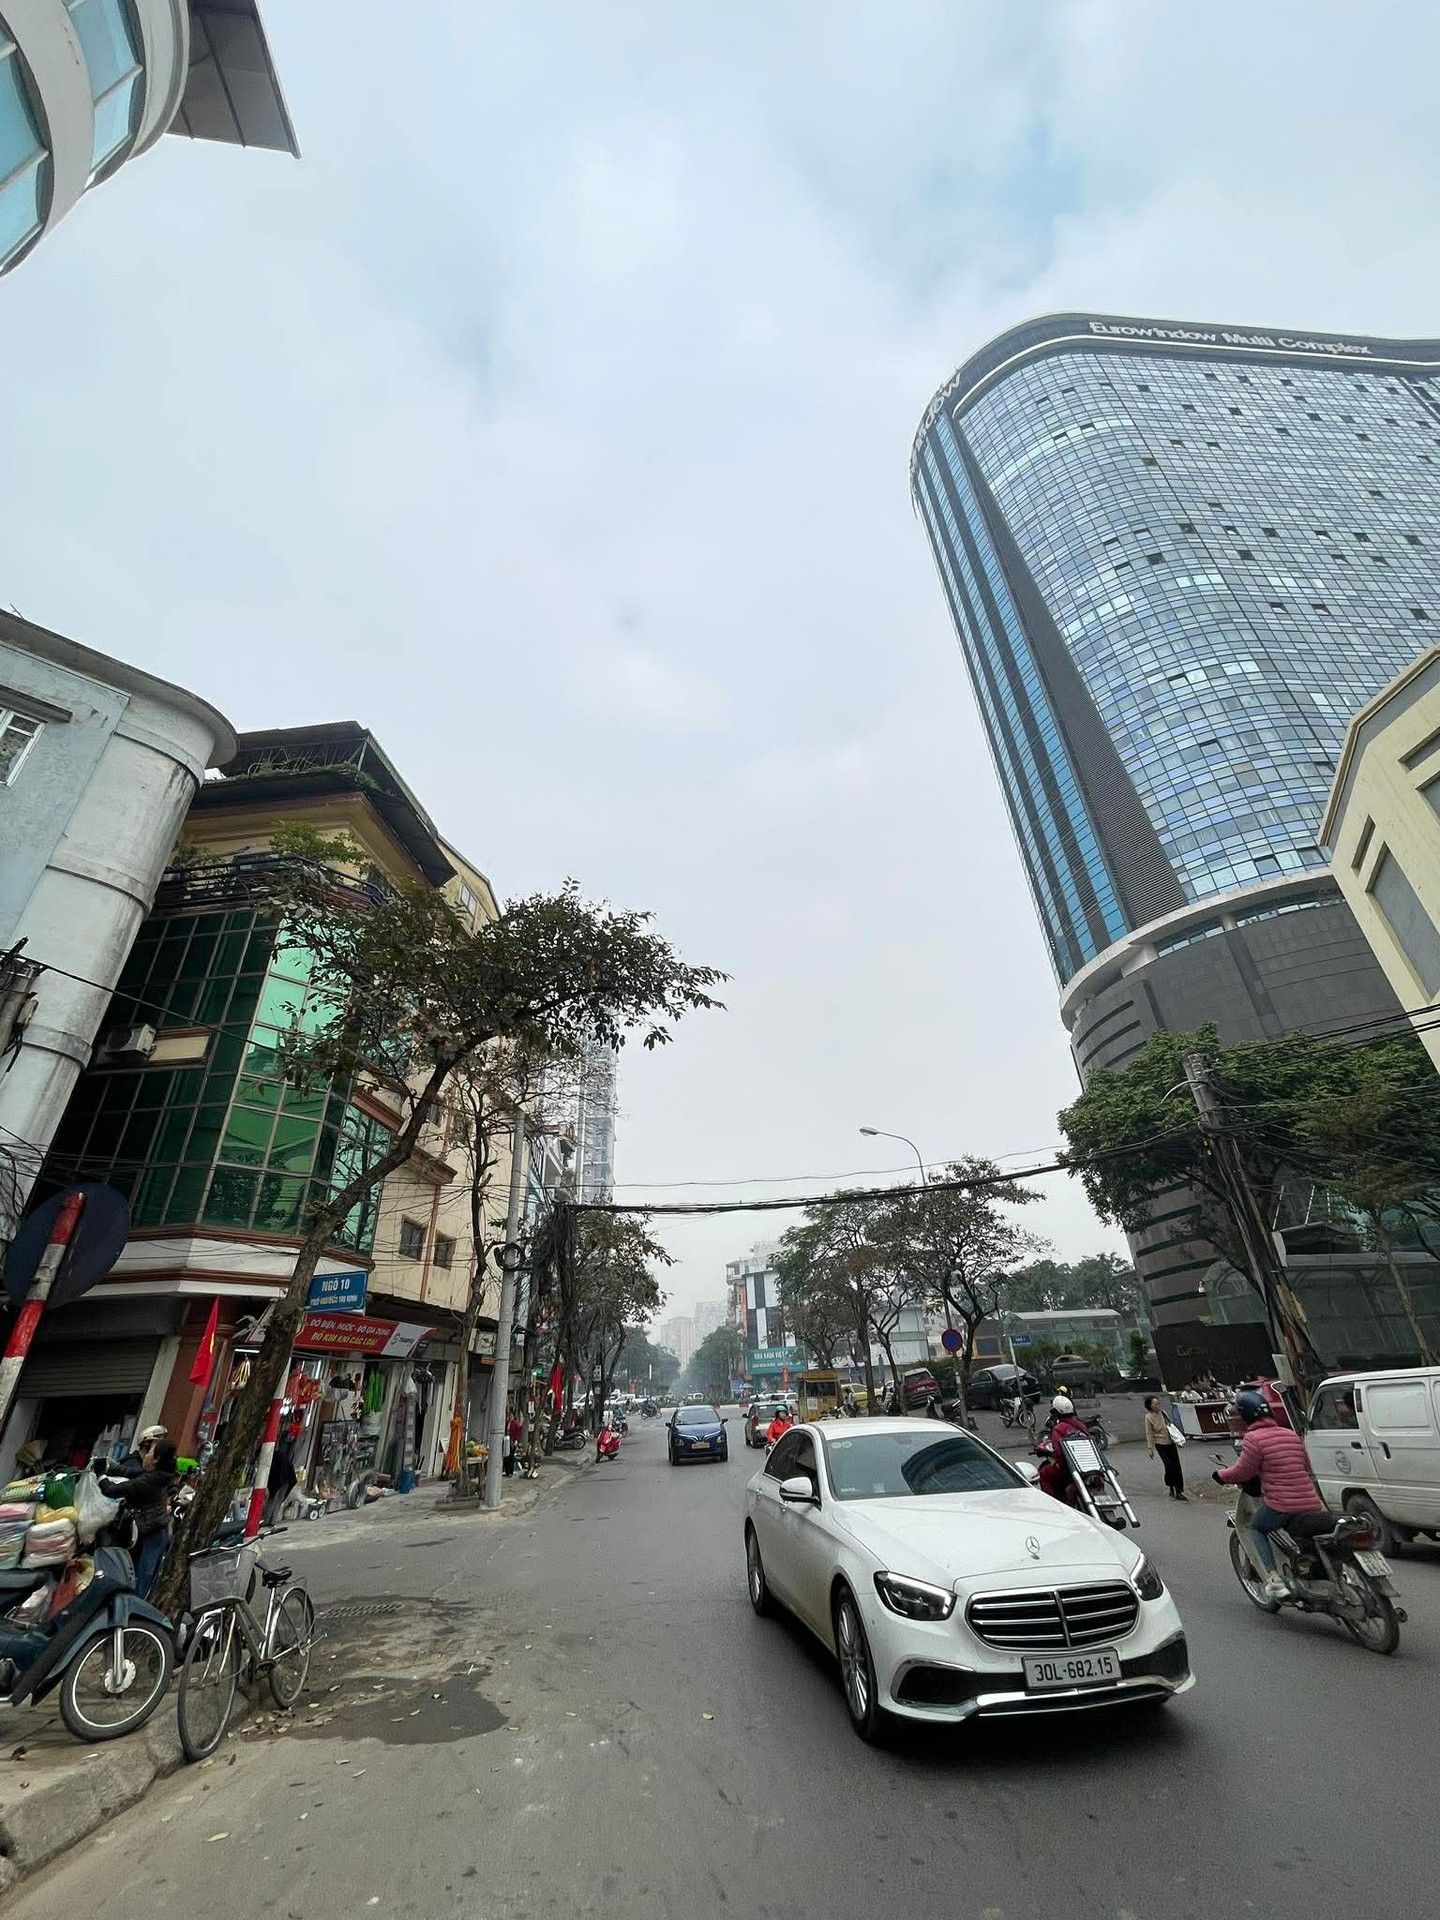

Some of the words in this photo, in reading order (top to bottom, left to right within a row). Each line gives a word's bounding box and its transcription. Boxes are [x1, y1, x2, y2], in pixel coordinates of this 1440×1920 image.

[1089, 321, 1216, 342] Eurowindow
[1221, 332, 1276, 347] Multi
[1278, 337, 1373, 355] Complex
[340, 1278, 351, 1290] 10
[1034, 1656, 1114, 1682] 30L-682.15
